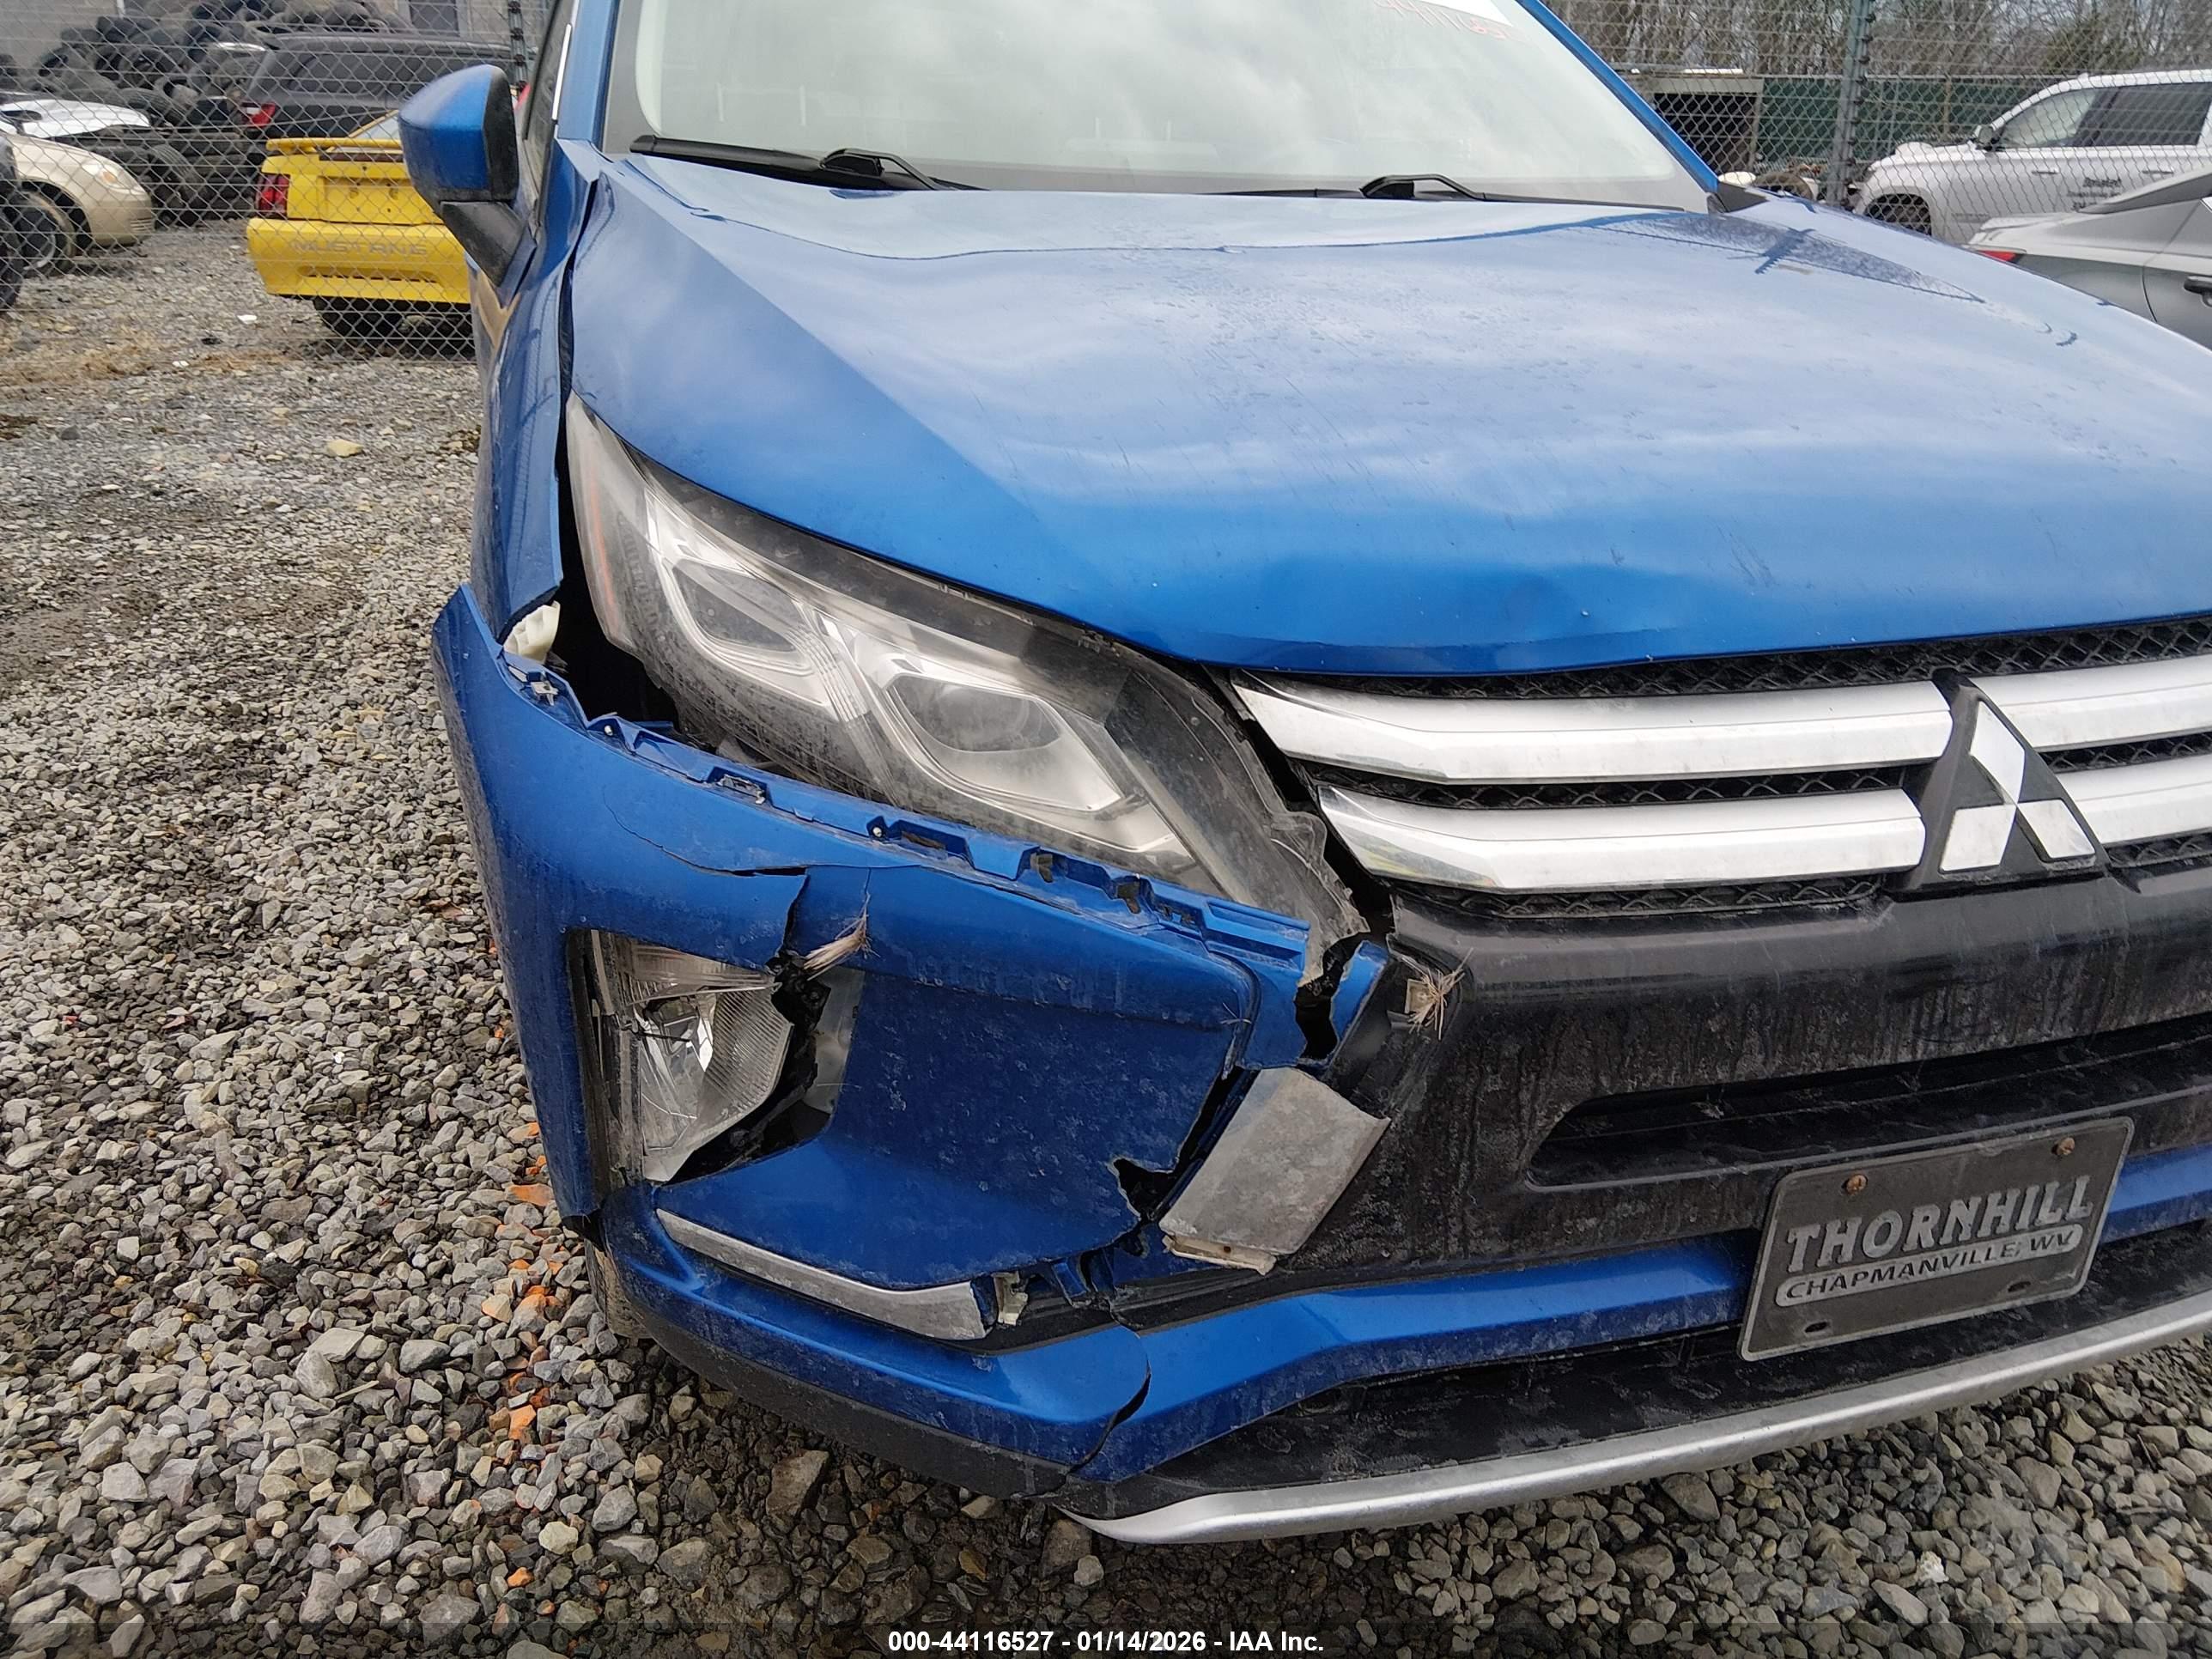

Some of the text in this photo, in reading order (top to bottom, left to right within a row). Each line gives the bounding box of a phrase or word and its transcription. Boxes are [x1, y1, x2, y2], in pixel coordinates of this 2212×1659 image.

[289, 240, 427, 257] MUSTANG
[1787, 1176, 2094, 1273] THORNHILL
[2029, 1230, 2075, 1252] WV
